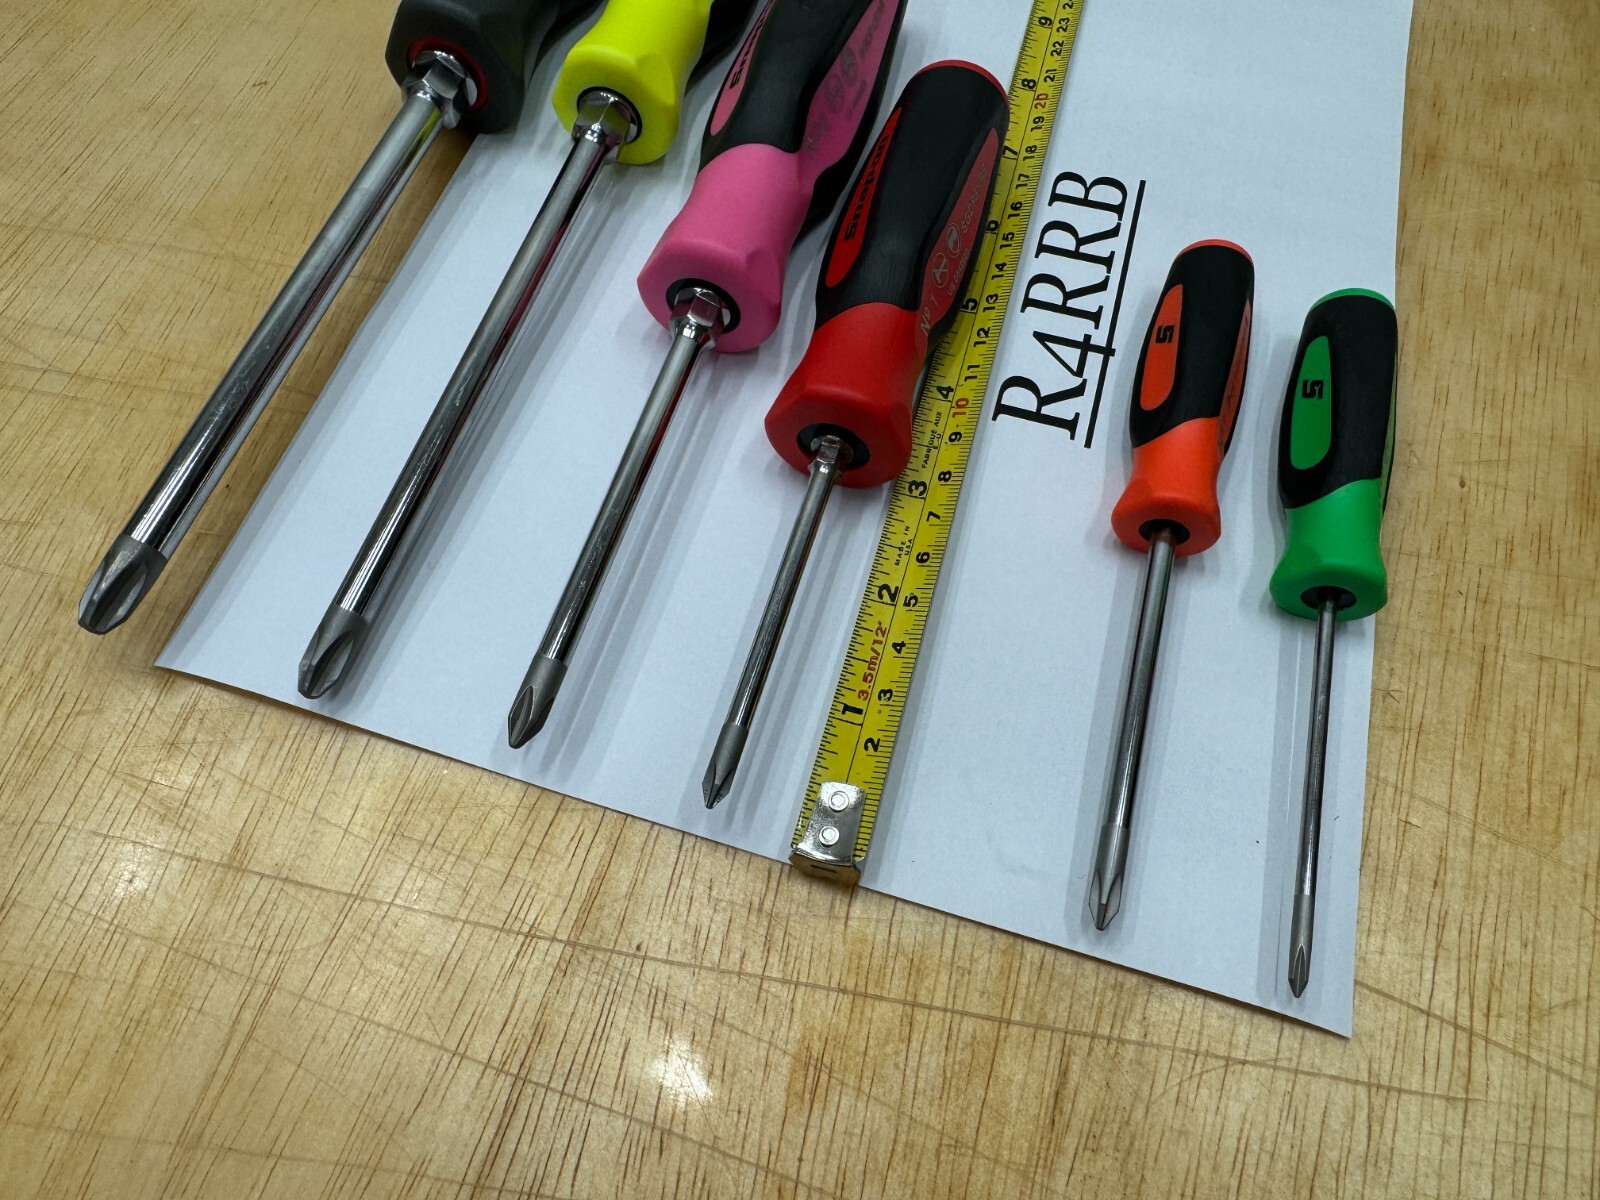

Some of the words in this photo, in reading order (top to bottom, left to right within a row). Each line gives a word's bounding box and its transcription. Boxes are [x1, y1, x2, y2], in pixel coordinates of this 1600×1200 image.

[1038, 16, 1053, 27] 9
[1056, 17, 1071, 33] 23
[1050, 40, 1064, 57] 22
[1043, 68, 1057, 83] 21
[1021, 78, 1036, 90] 8
[1034, 93, 1049, 109] 20
[1030, 115, 1045, 132] 19
[1003, 145, 1018, 156] 7
[1023, 144, 1037, 161] 18
[1015, 173, 1030, 189] 17
[1008, 201, 1023, 219] 16
[999, 231, 1015, 250] 15
[991, 261, 1008, 280] 14
[962, 298, 978, 311] 5
[983, 293, 999, 313] 13
[991, 171, 1128, 440] R4RRB
[974, 327, 991, 347] 12
[964, 364, 980, 382] 11
[936, 385, 954, 399] 4
[952, 397, 970, 418] 10
[933, 411, 943, 427] AUX
[948, 431, 963, 443] 9
[938, 470, 952, 483] 8
[908, 480, 928, 496] 3
[926, 511, 941, 522] 7
[895, 540, 907, 566] MADE
[903, 525, 910, 536] IN
[916, 551, 931, 564] 6
[877, 583, 900, 602] 2
[903, 594, 919, 608] 5
[892, 640, 907, 655] 4
[877, 688, 893, 702] 3
[841, 703, 864, 716] 1
[864, 737, 881, 752] 2
